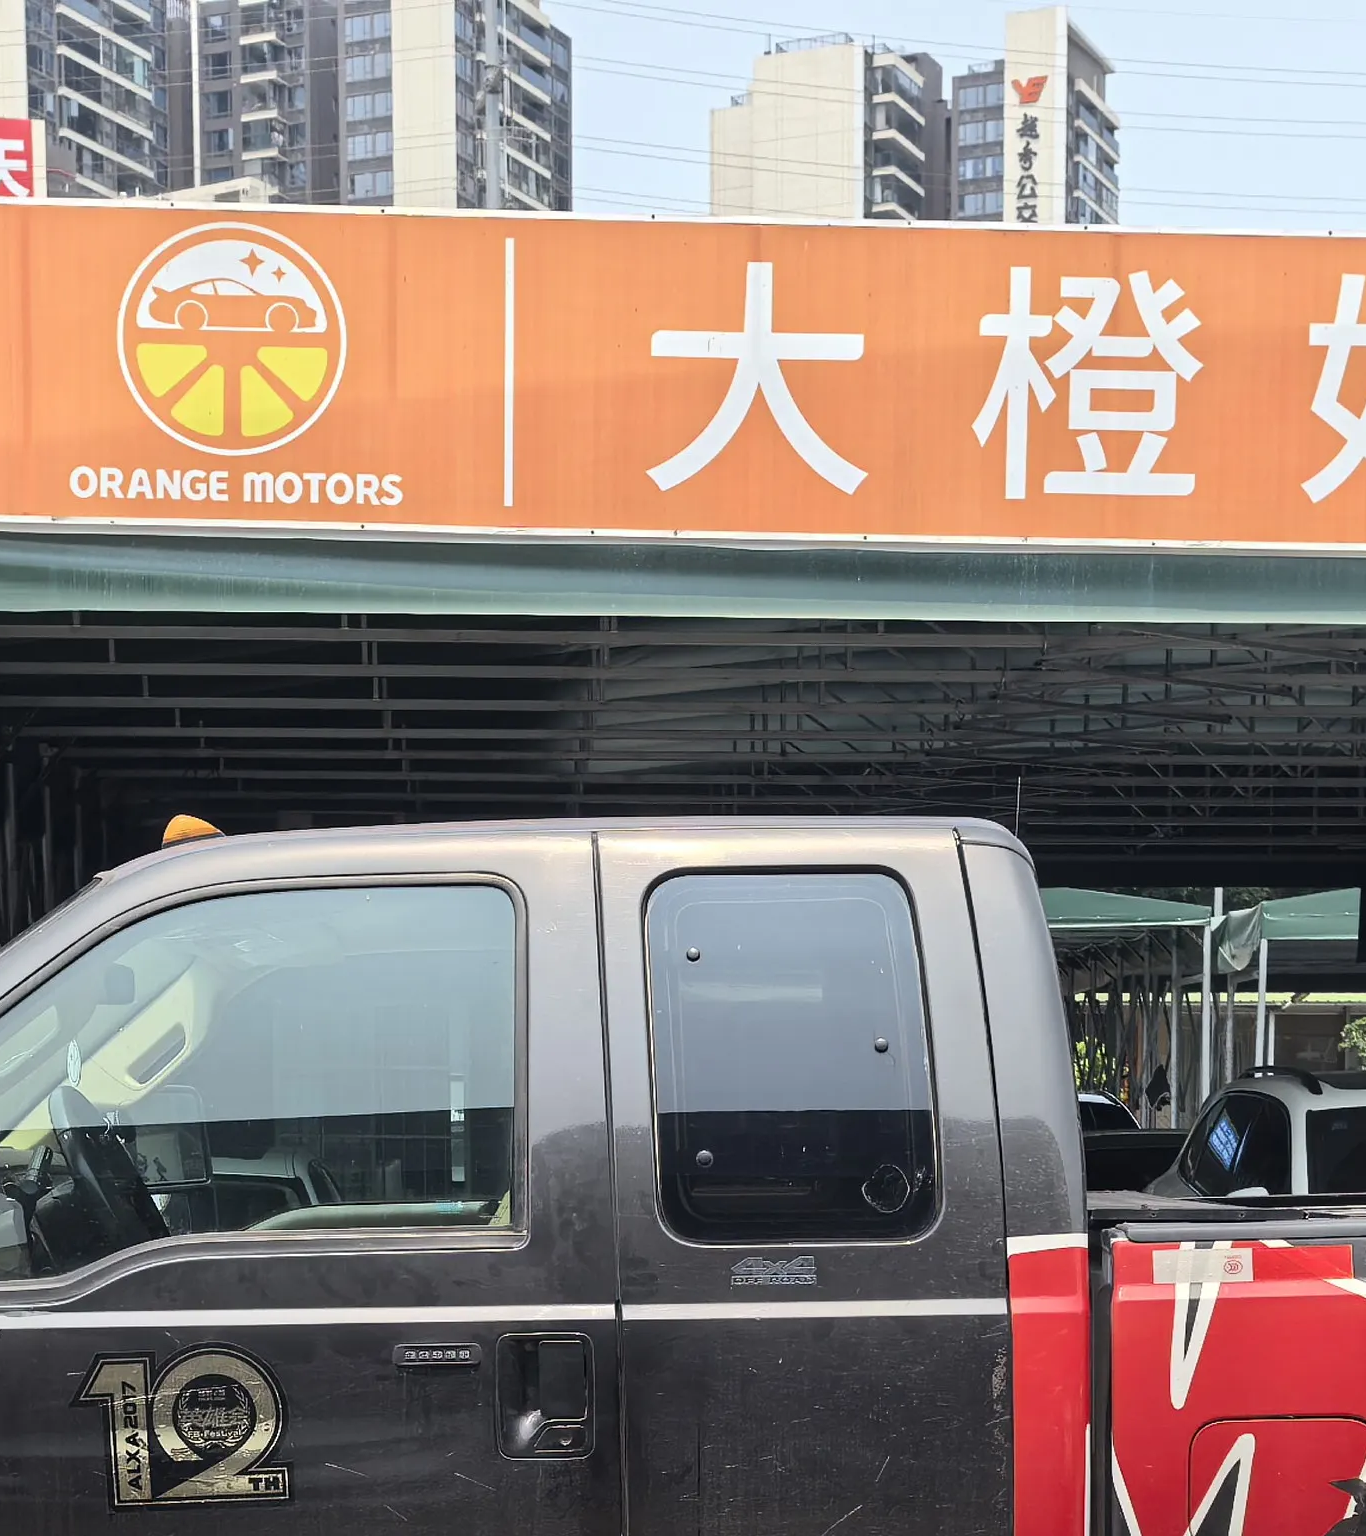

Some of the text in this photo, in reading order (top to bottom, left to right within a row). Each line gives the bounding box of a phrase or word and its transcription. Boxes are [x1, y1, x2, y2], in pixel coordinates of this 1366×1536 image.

[69, 465, 403, 506] ORANGE MOTORS
[125, 1432, 145, 1492] ALXA
